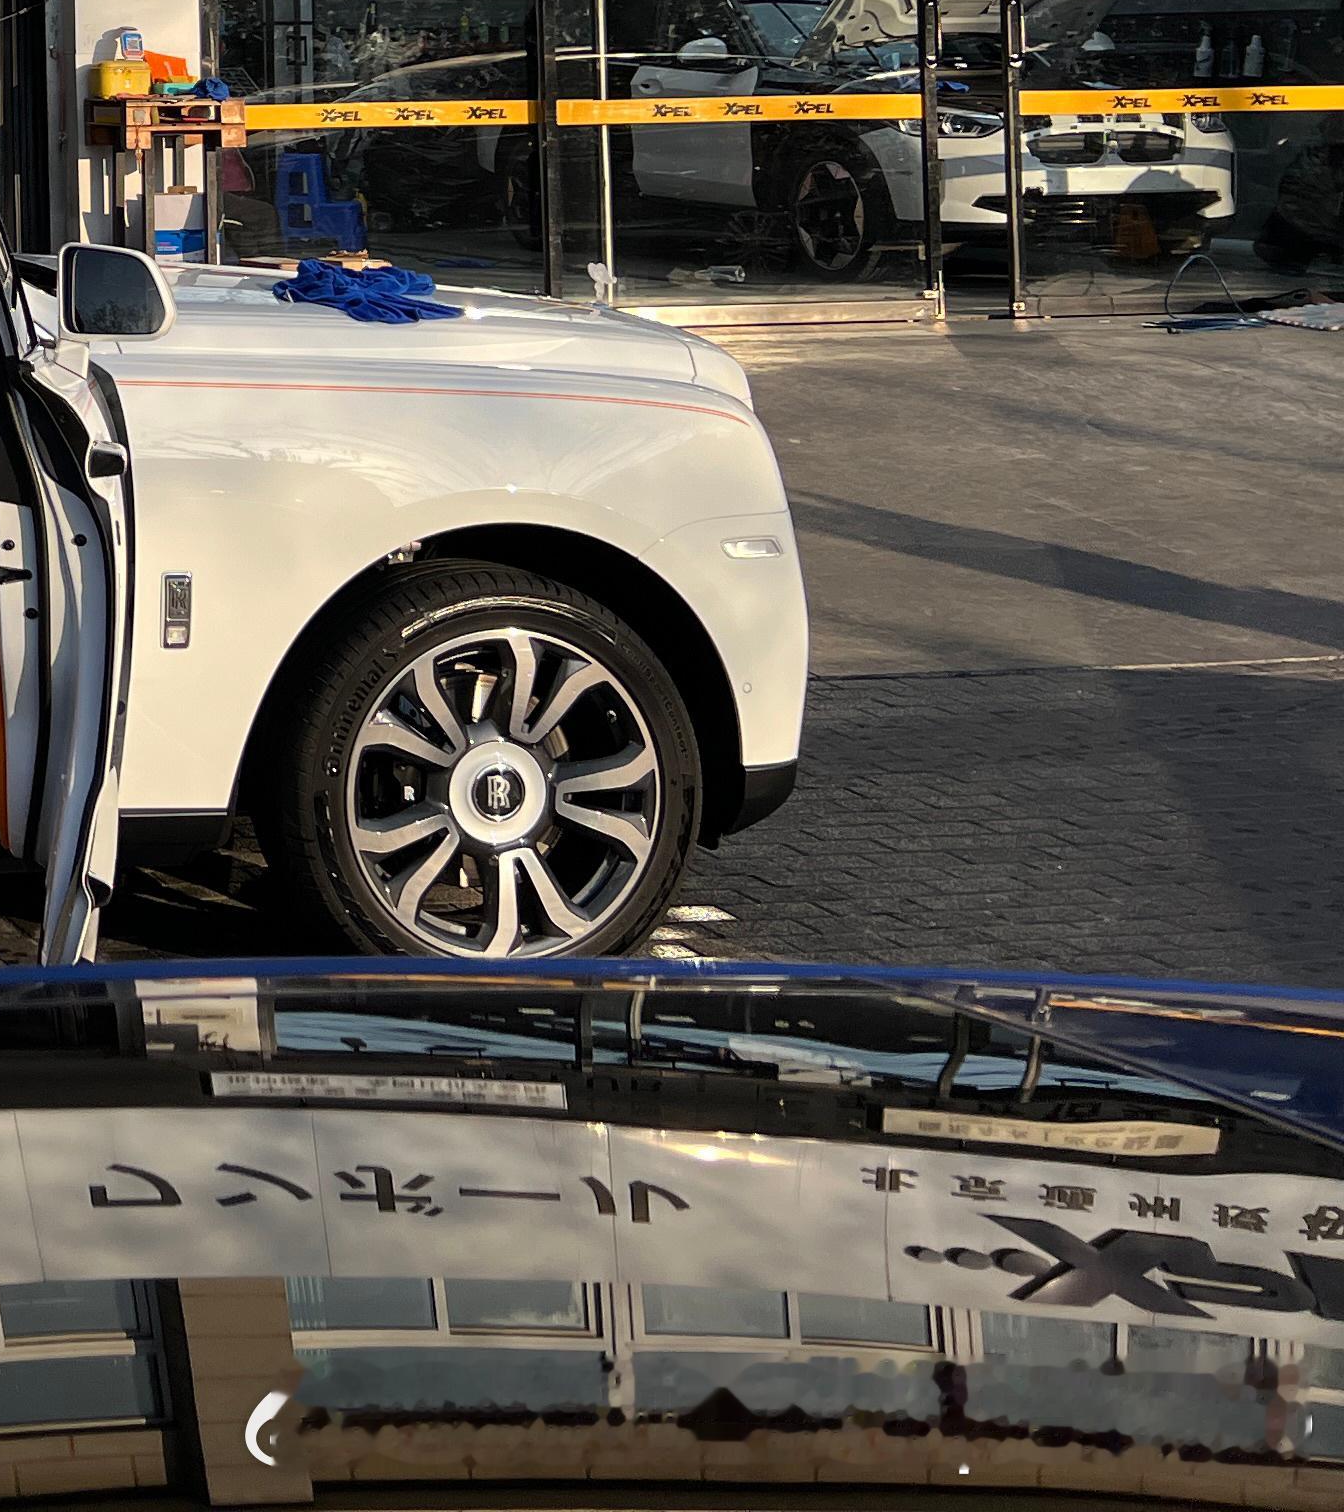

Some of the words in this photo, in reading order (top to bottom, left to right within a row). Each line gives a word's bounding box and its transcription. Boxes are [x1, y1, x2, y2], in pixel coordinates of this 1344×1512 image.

[723, 102, 763, 115] XPEL
[794, 101, 834, 114] XPEL
[1111, 95, 1152, 108] XPEL
[1182, 94, 1221, 107] XPEL
[1251, 92, 1289, 105] XPEL
[320, 108, 362, 122] XPEL
[393, 107, 435, 121] XPEL
[467, 106, 508, 119] XPEL
